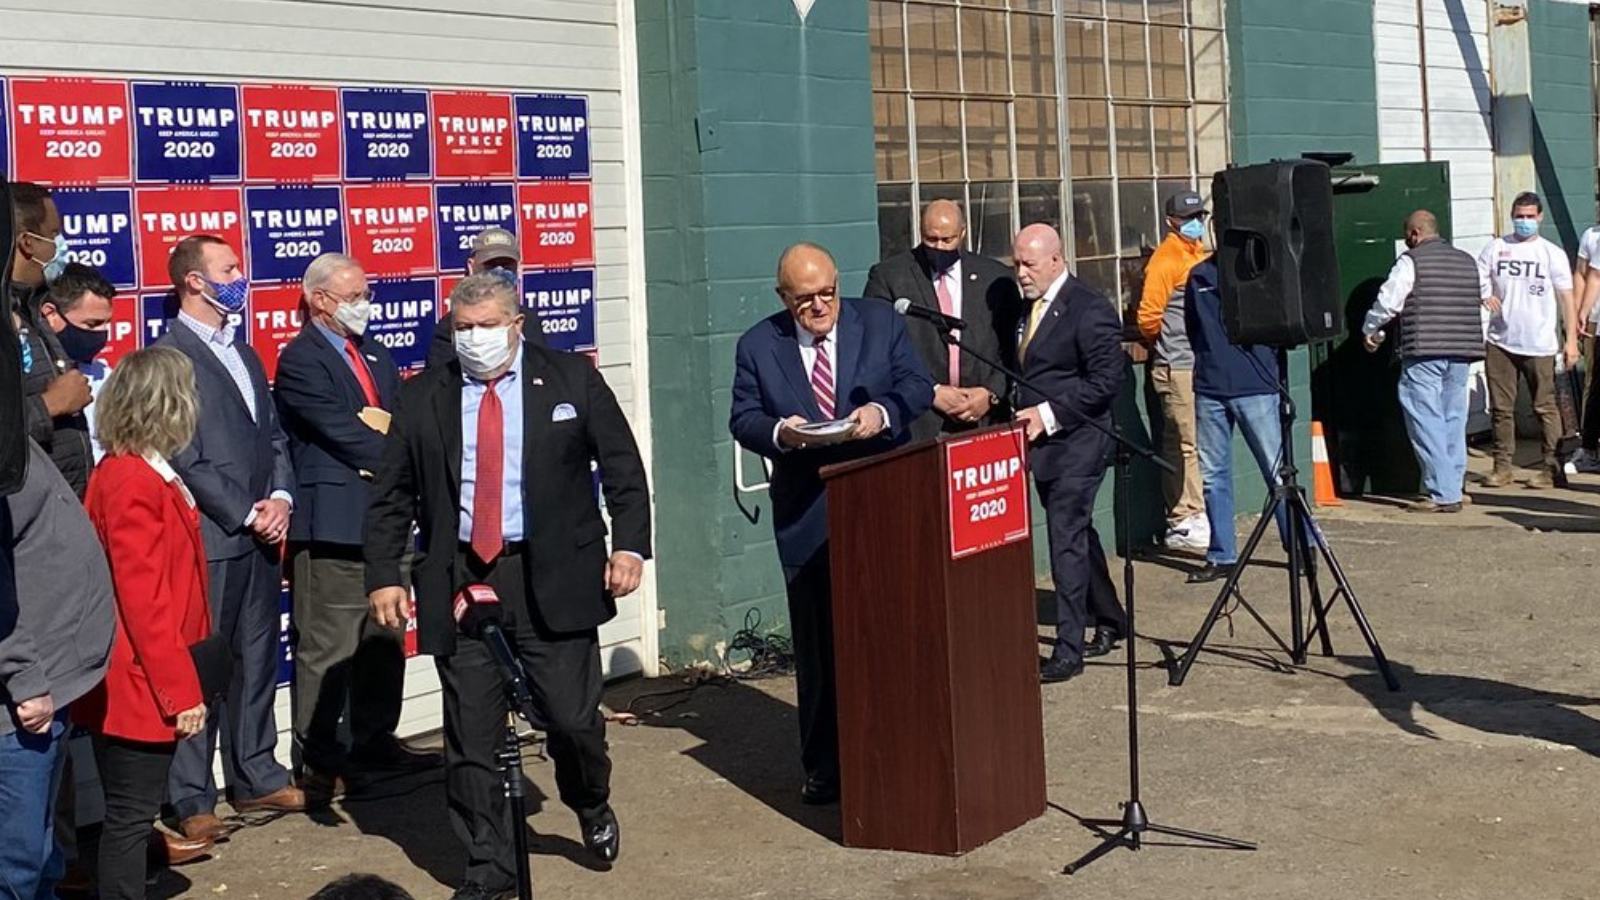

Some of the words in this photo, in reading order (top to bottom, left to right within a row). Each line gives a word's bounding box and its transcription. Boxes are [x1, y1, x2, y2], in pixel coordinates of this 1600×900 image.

[18, 105, 123, 125] TRUMP
[139, 107, 234, 127] TRUMP
[248, 109, 335, 128] TRUMP
[347, 112, 425, 129] TRUMP
[439, 117, 508, 133] TRUMP
[519, 116, 585, 132] TRUMP
[46, 141, 101, 157] 2020
[164, 142, 215, 157] 2020
[271, 142, 317, 157] 2020
[368, 143, 409, 157] 2020
[447, 136, 502, 147] PENCE
[537, 145, 571, 158] 2020
[251, 209, 338, 228] TRUMP
[348, 207, 430, 225] TRUMP
[440, 204, 512, 222] TRUMP
[522, 203, 588, 219] TRUMP
[63, 213, 127, 234] UMP
[142, 211, 237, 231] TRUMP
[373, 237, 413, 253] 2020
[540, 231, 574, 245] 2020
[66, 250, 106, 266] 020
[274, 241, 321, 258] 2020
[1496, 260, 1545, 279] FSTL
[525, 289, 591, 308] TRUMP
[369, 299, 433, 321] RUMP
[256, 310, 304, 329] TRU
[542, 318, 577, 333] 2020
[953, 457, 1020, 491] TRUMP
[970, 497, 1006, 522] 2020
